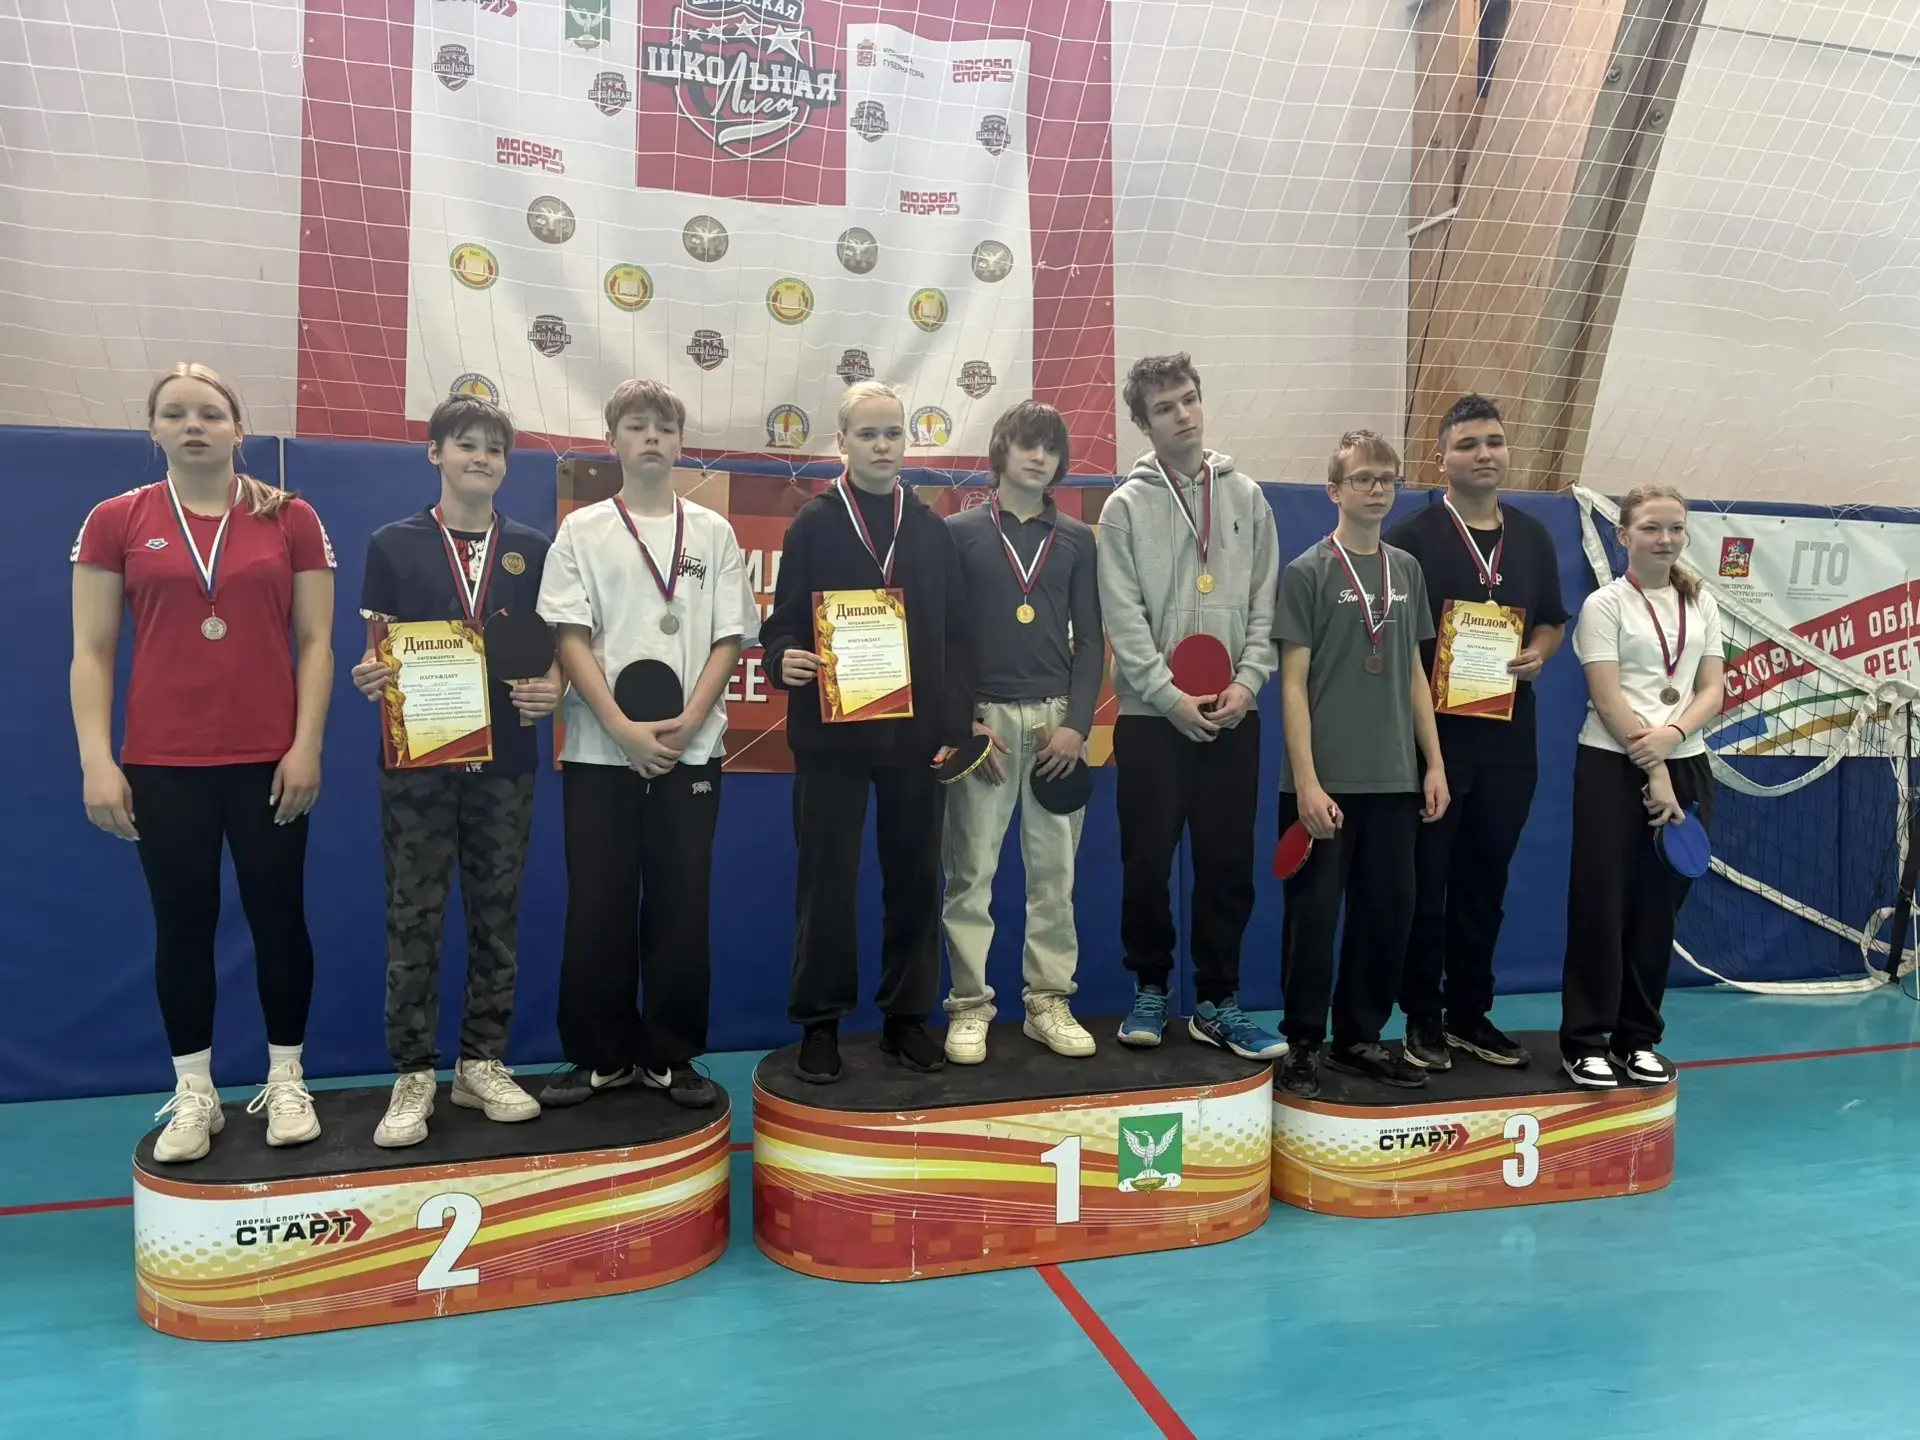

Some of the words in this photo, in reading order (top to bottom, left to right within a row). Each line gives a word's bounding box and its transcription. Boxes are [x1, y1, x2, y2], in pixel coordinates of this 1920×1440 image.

[648, 46, 837, 101] ШКОЛЬНАЯ
[711, 51, 799, 116] Лига
[953, 70, 1000, 83] СПОРТ
[497, 137, 563, 161] МОСОБЛ
[497, 151, 548, 170] СПОРТ
[900, 190, 958, 203] МОСОБЛ
[900, 203, 946, 216] СПОРТ
[1789, 540, 1850, 587] ГТО
[836, 603, 887, 620] Диплом
[1460, 611, 1508, 629] Диплом
[403, 636, 464, 655] Диплом
[1726, 614, 1855, 698] СКОВСКИЙ
[1379, 1130, 1456, 1151] СТАРТ
[1502, 1114, 1541, 1188] 3
[1040, 1135, 1082, 1225] 1
[236, 1217, 271, 1227] ДВОРЕЦ
[276, 1213, 311, 1223] СПОРТА
[236, 1216, 352, 1246] СТАРТ
[416, 1191, 484, 1292] 2
